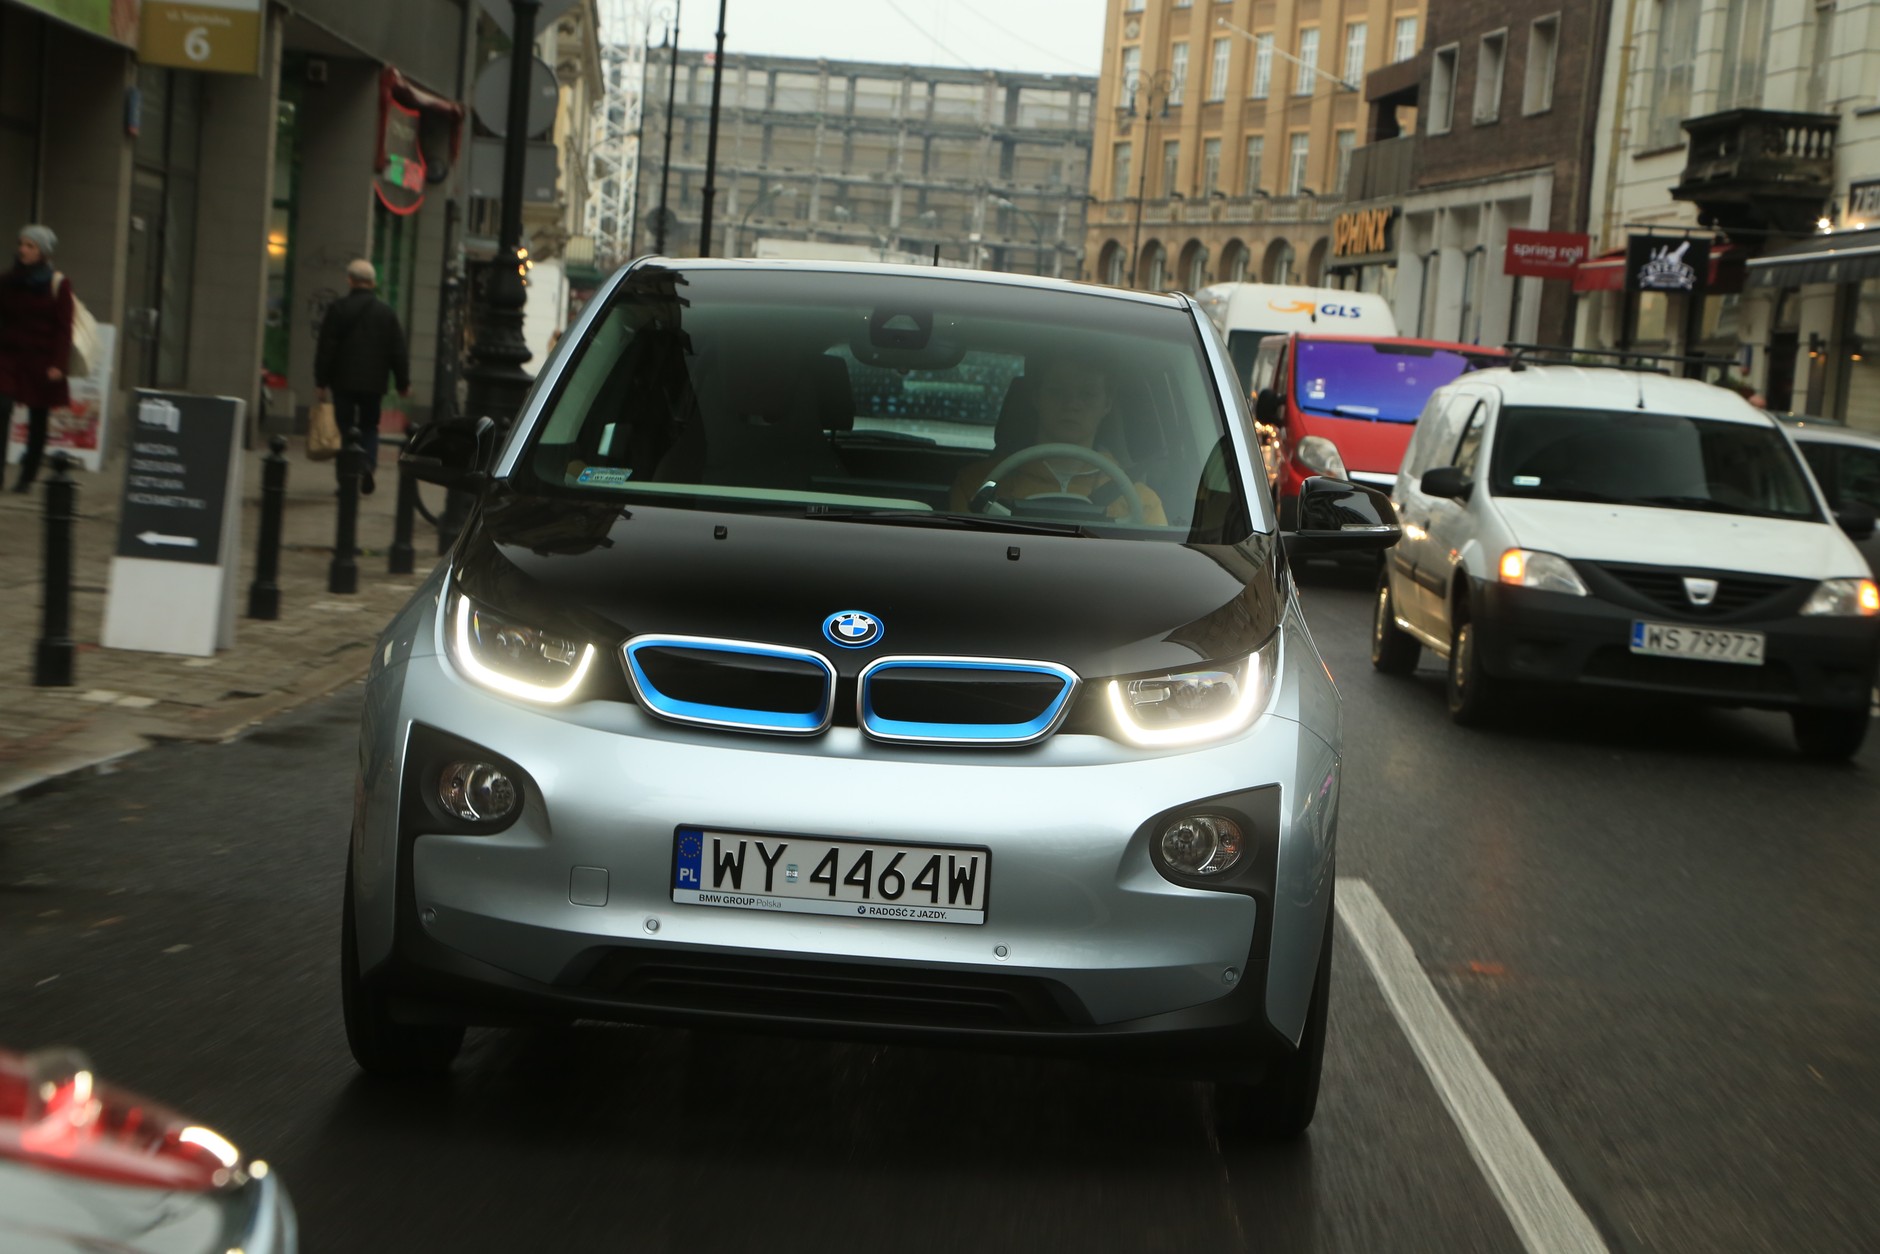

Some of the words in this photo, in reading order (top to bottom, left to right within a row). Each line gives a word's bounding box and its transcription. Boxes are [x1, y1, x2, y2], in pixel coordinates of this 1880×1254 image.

[184, 27, 211, 62] 6
[1513, 243, 1557, 259] spring
[1560, 245, 1584, 258] roll
[1321, 303, 1361, 318] GLS
[1648, 627, 1680, 650] WS
[1688, 630, 1760, 658] 79972
[679, 867, 698, 882] PL
[713, 837, 788, 892] WY
[810, 845, 979, 906] 4464W
[699, 894, 722, 903] BMW
[723, 897, 755, 906] GROUP
[756, 898, 782, 909] Polska
[869, 907, 908, 918] RADOŚĆ
[909, 909, 916, 918] Z
[917, 909, 947, 920] JAZDY.
